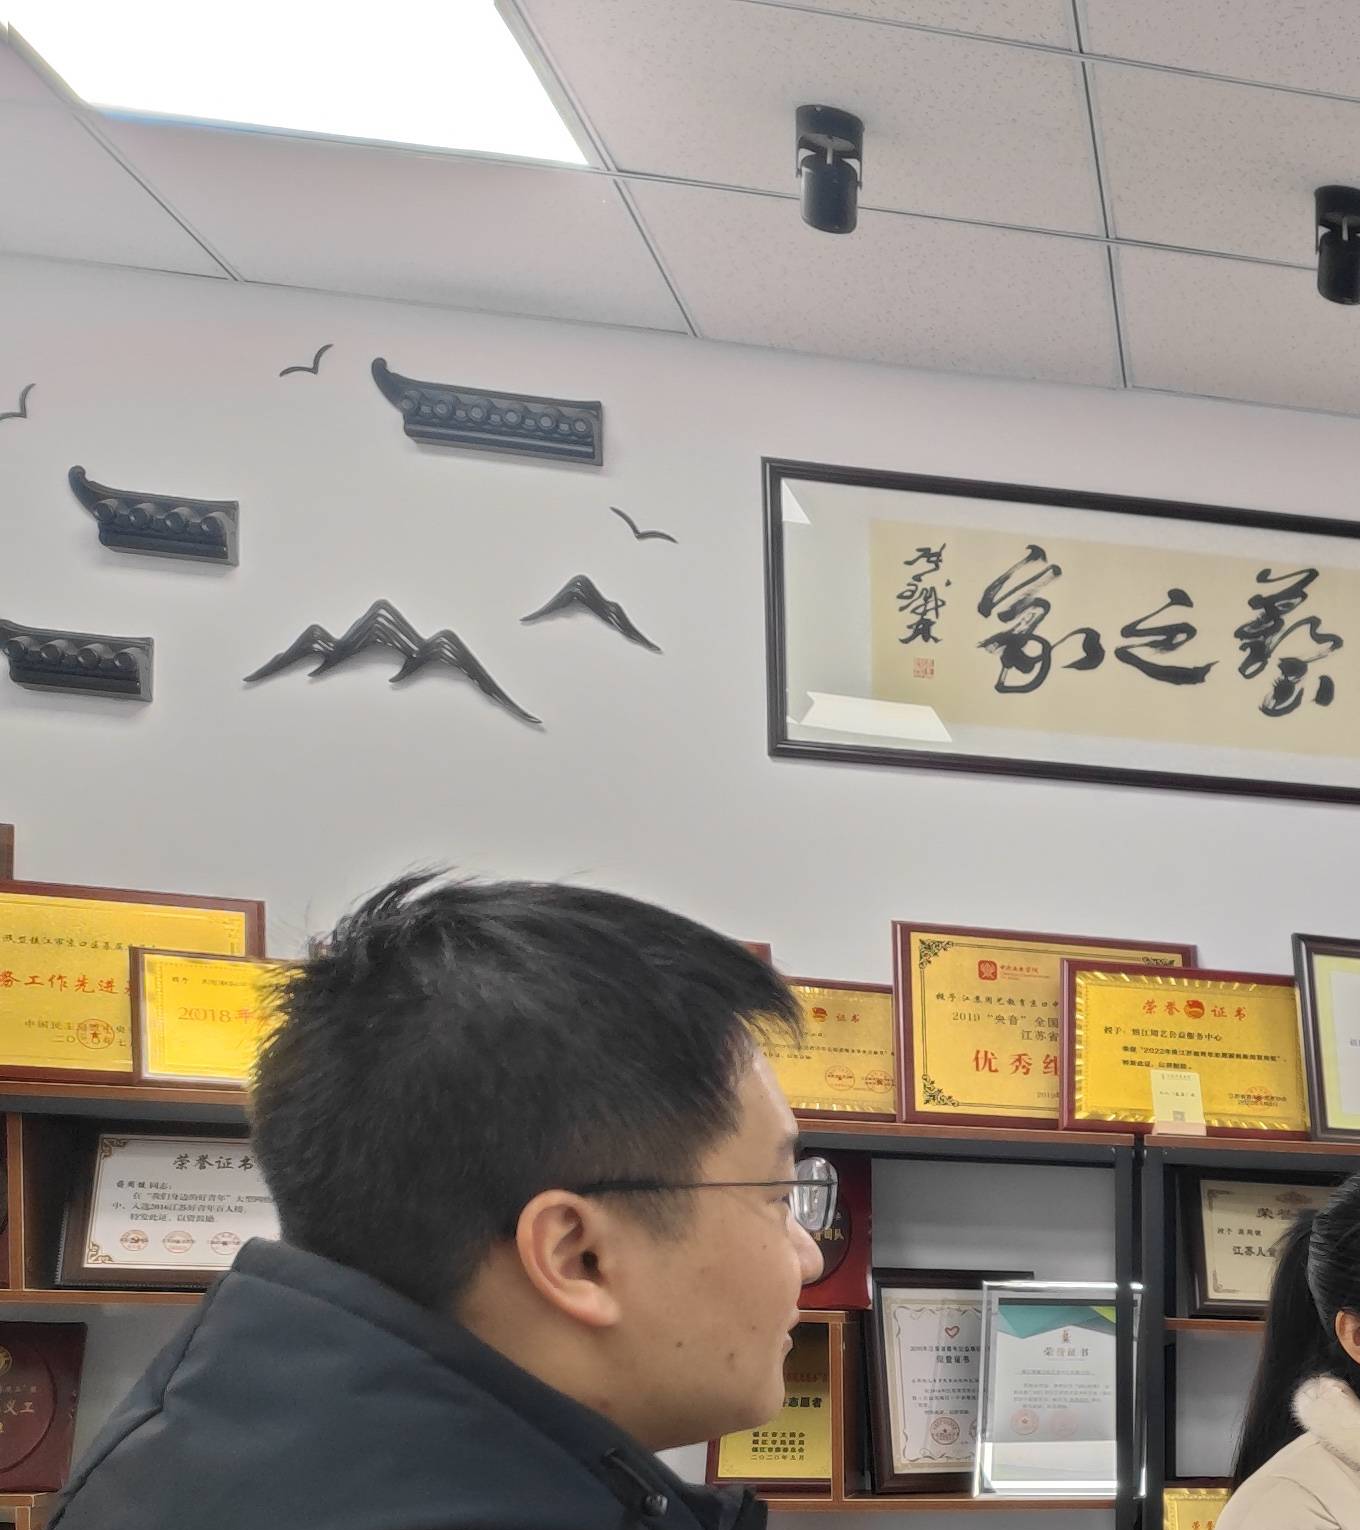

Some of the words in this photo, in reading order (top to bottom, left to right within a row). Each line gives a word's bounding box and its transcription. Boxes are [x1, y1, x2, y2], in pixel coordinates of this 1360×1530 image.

[0, 971, 131, 996] 务工作先进
[1210, 1005, 1248, 1021] 证书
[173, 1153, 256, 1171] 荣誉证书
[782, 1396, 822, 1408] 志愿者
